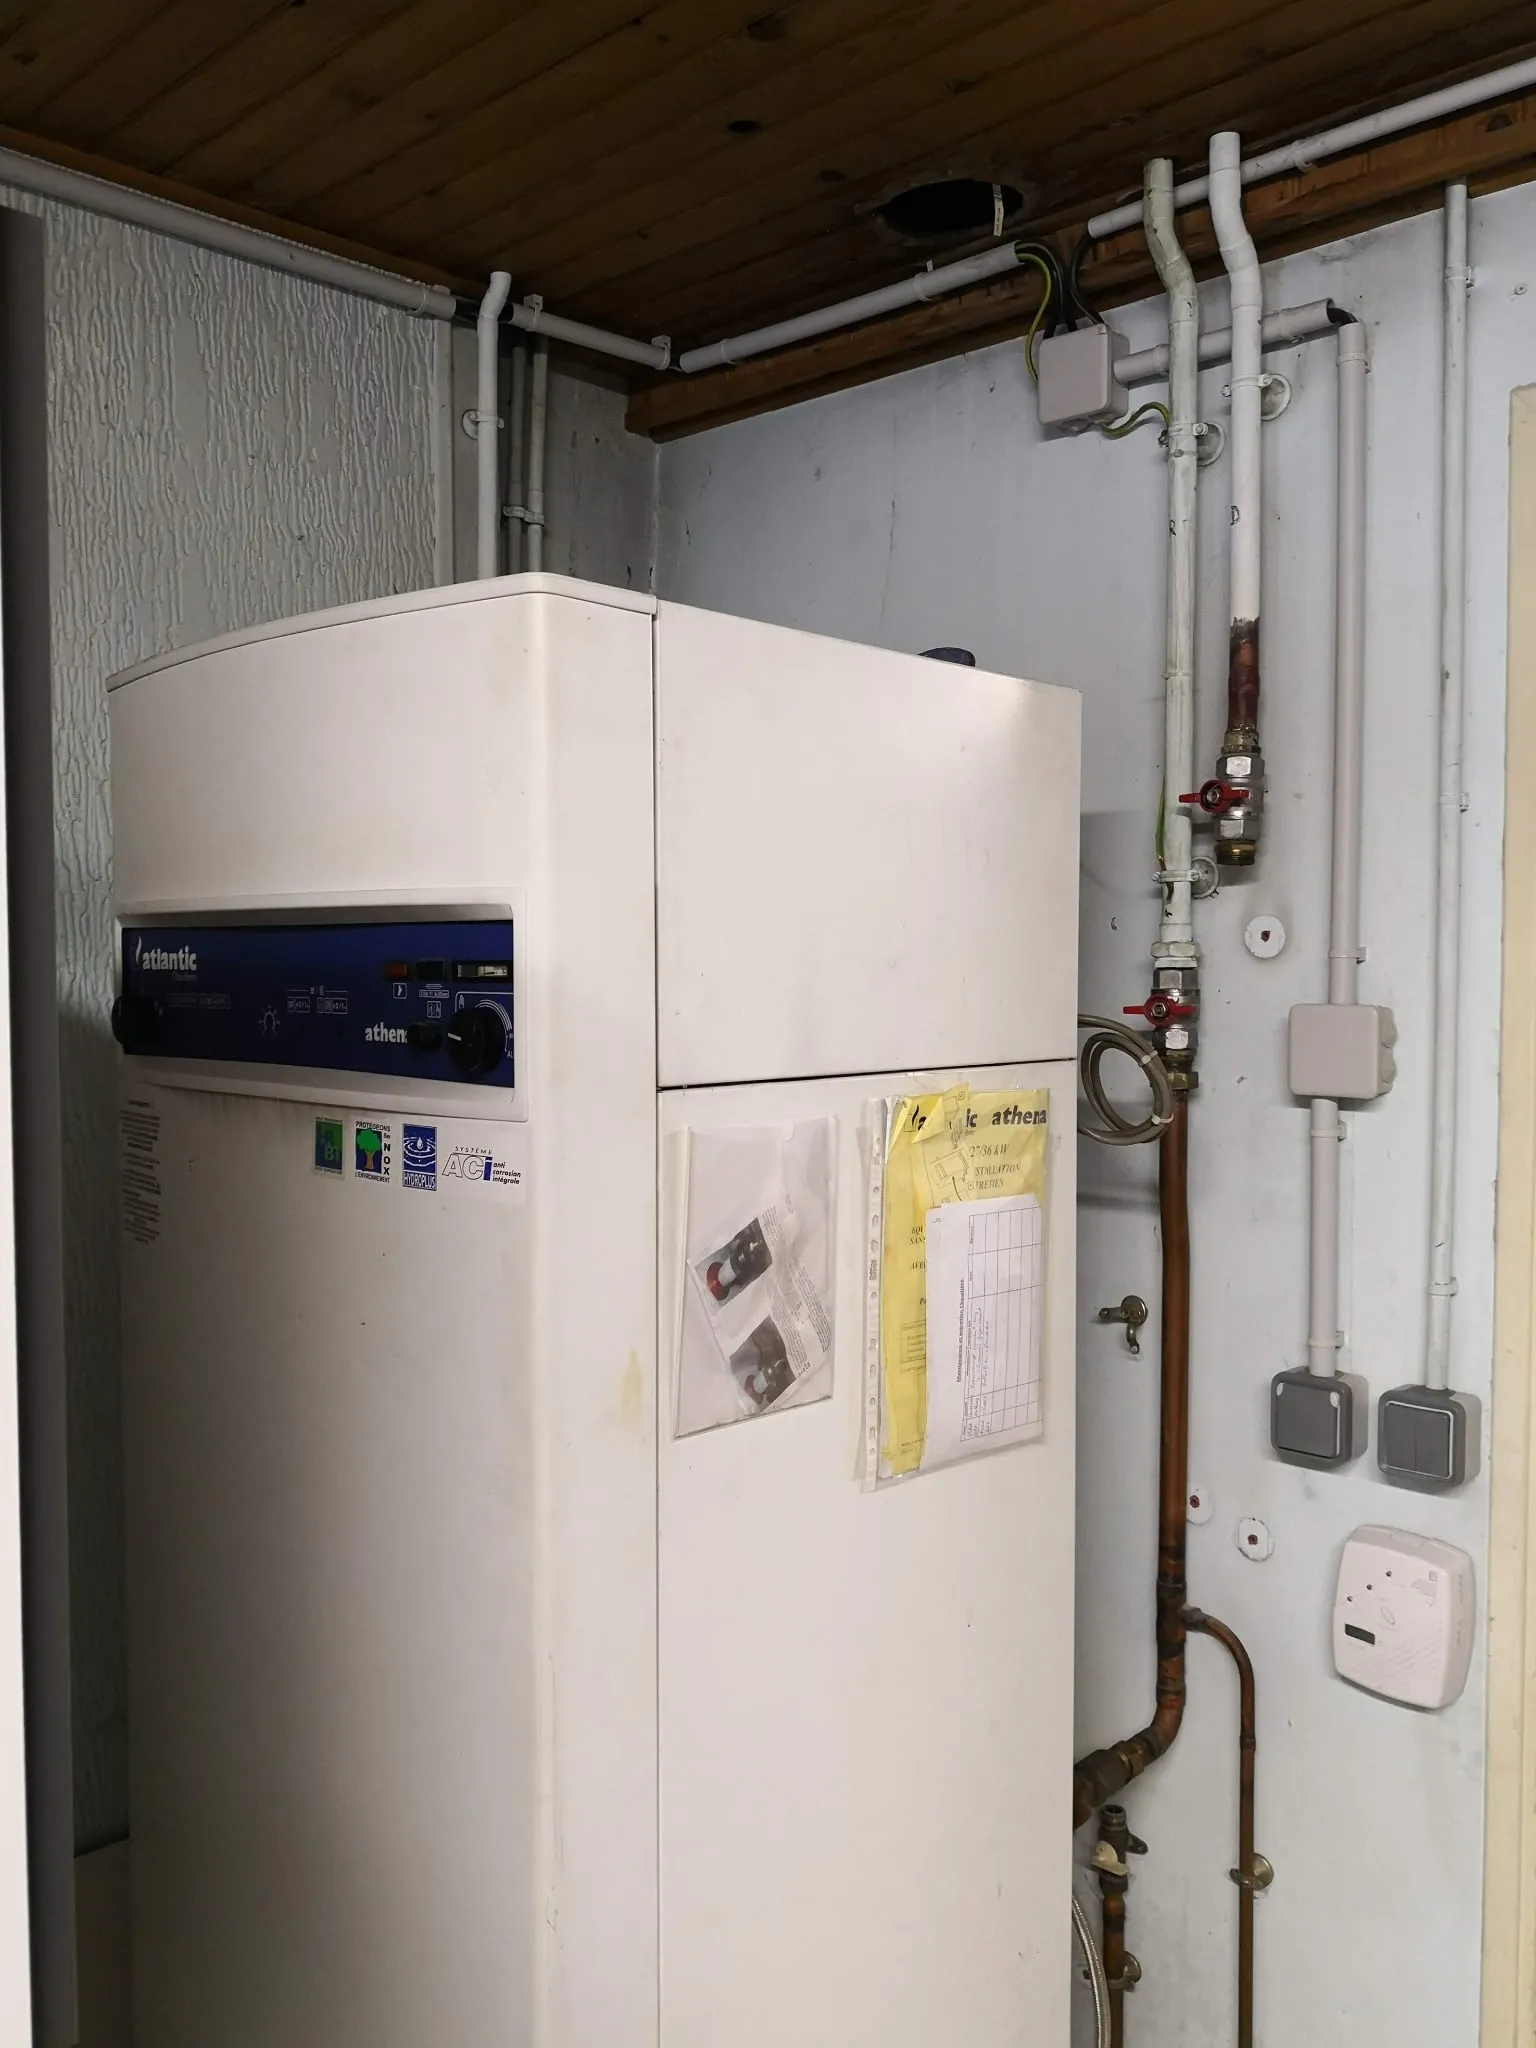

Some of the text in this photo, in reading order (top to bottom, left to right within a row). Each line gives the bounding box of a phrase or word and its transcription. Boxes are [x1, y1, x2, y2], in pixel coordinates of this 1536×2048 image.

[142, 945, 197, 971] atlantic
[364, 1021, 408, 1044] athen
[992, 1104, 1047, 1127] athena
[492, 1169, 521, 1178] corrosion
[975, 1163, 1020, 1177] STALLATION
[403, 1172, 437, 1189] HYDROPLUS
